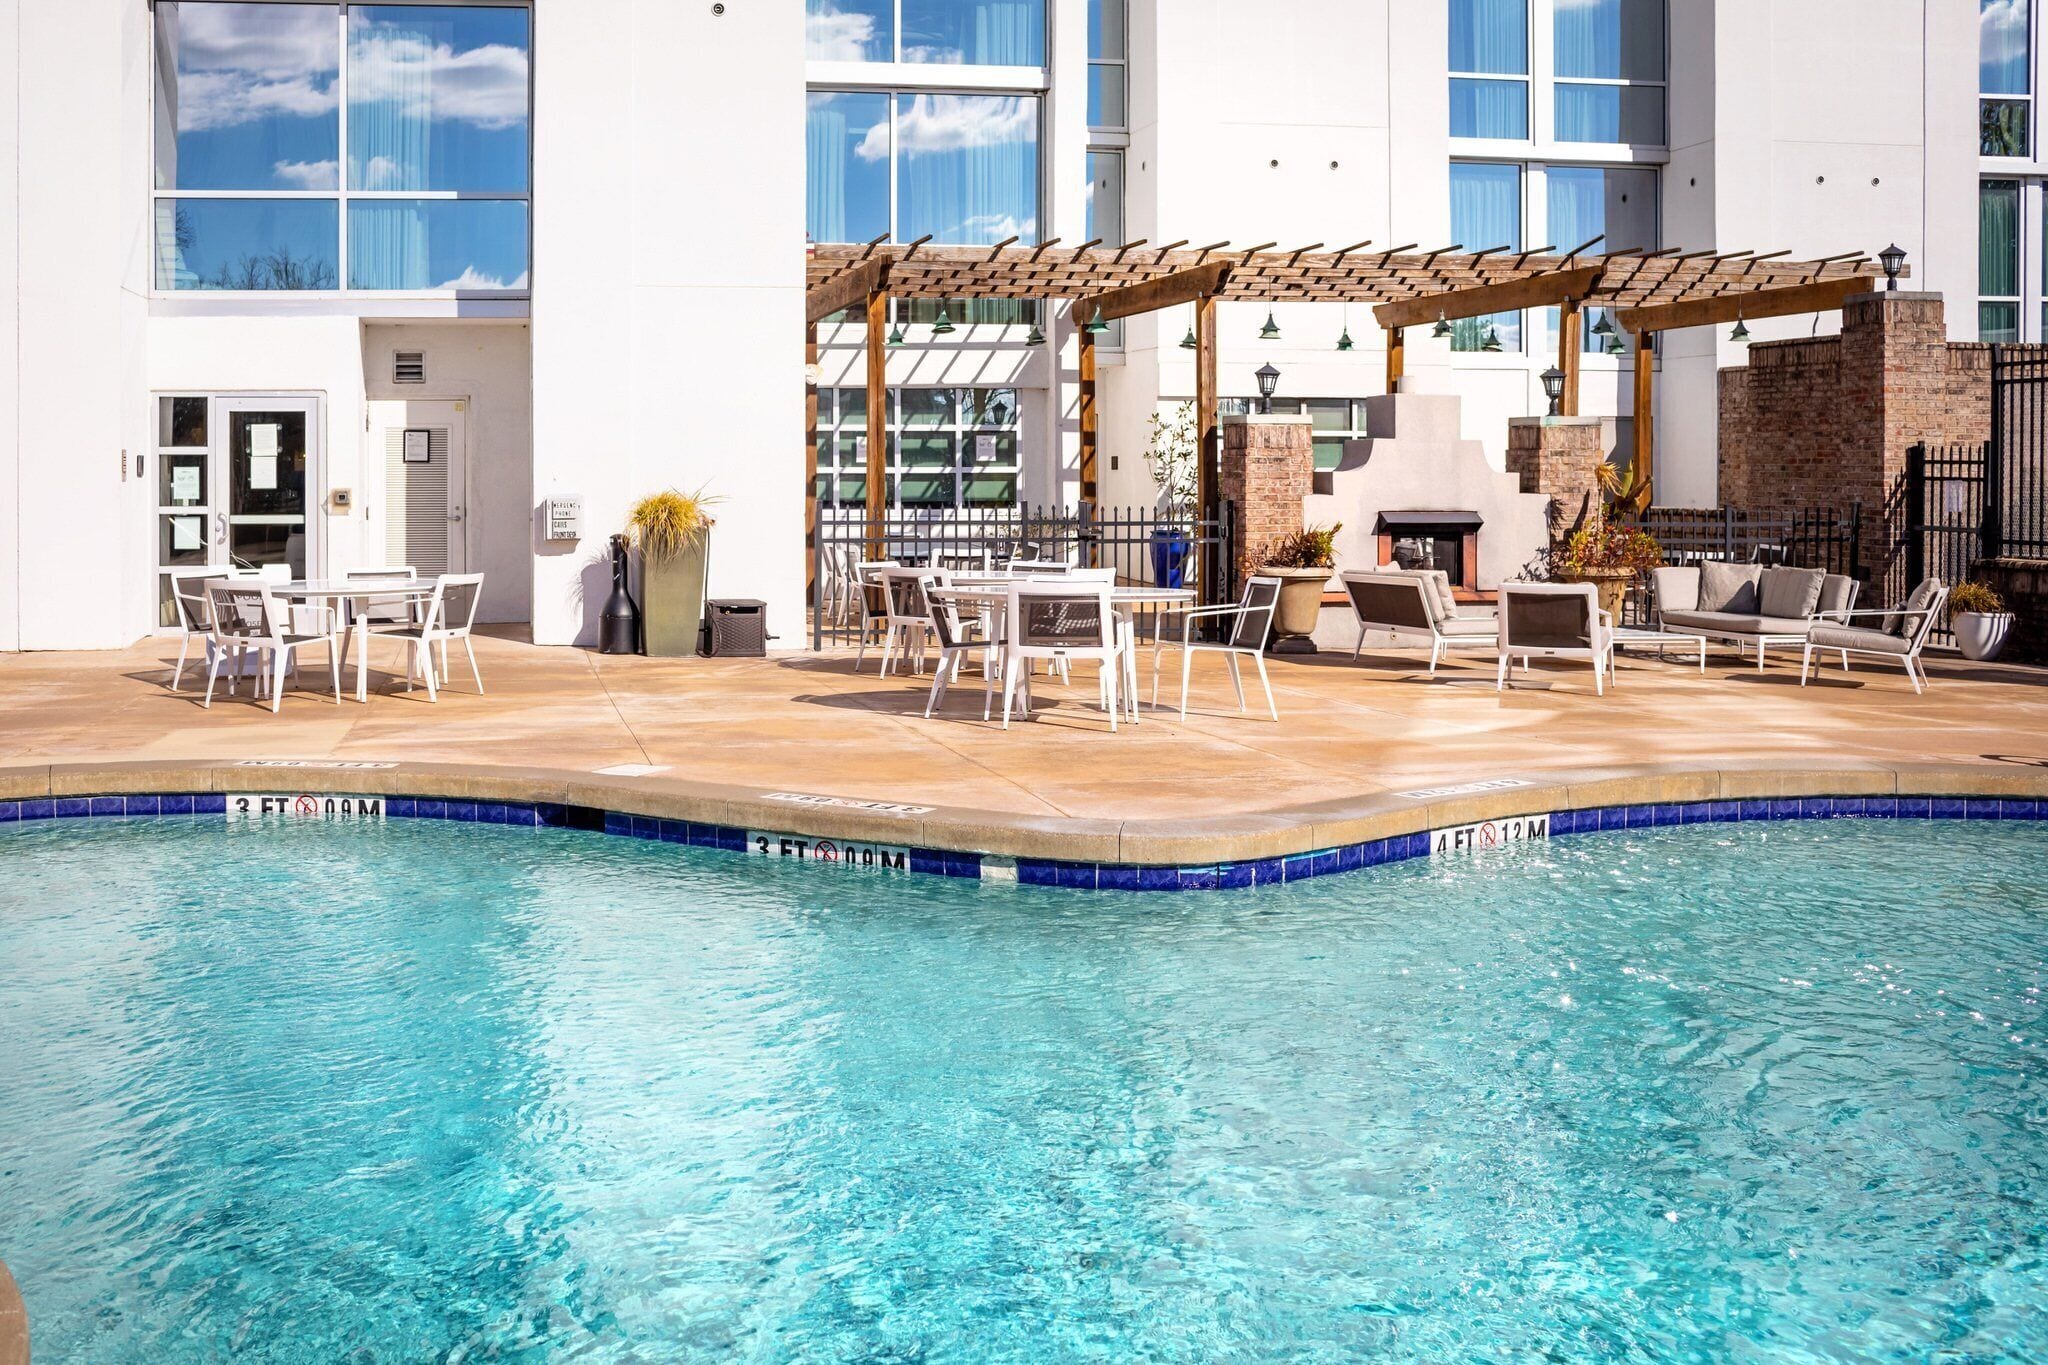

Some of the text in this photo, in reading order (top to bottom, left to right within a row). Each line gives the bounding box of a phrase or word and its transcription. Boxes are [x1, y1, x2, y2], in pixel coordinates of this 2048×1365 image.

[235, 797, 250, 813] 3
[261, 797, 289, 813] FT
[358, 799, 380, 815] M
[1437, 833, 1447, 852] 4
[1455, 828, 1475, 849] FT
[1528, 819, 1546, 839] M
[756, 836, 769, 854] 3
[781, 838, 808, 858] FT
[881, 850, 905, 870] M
